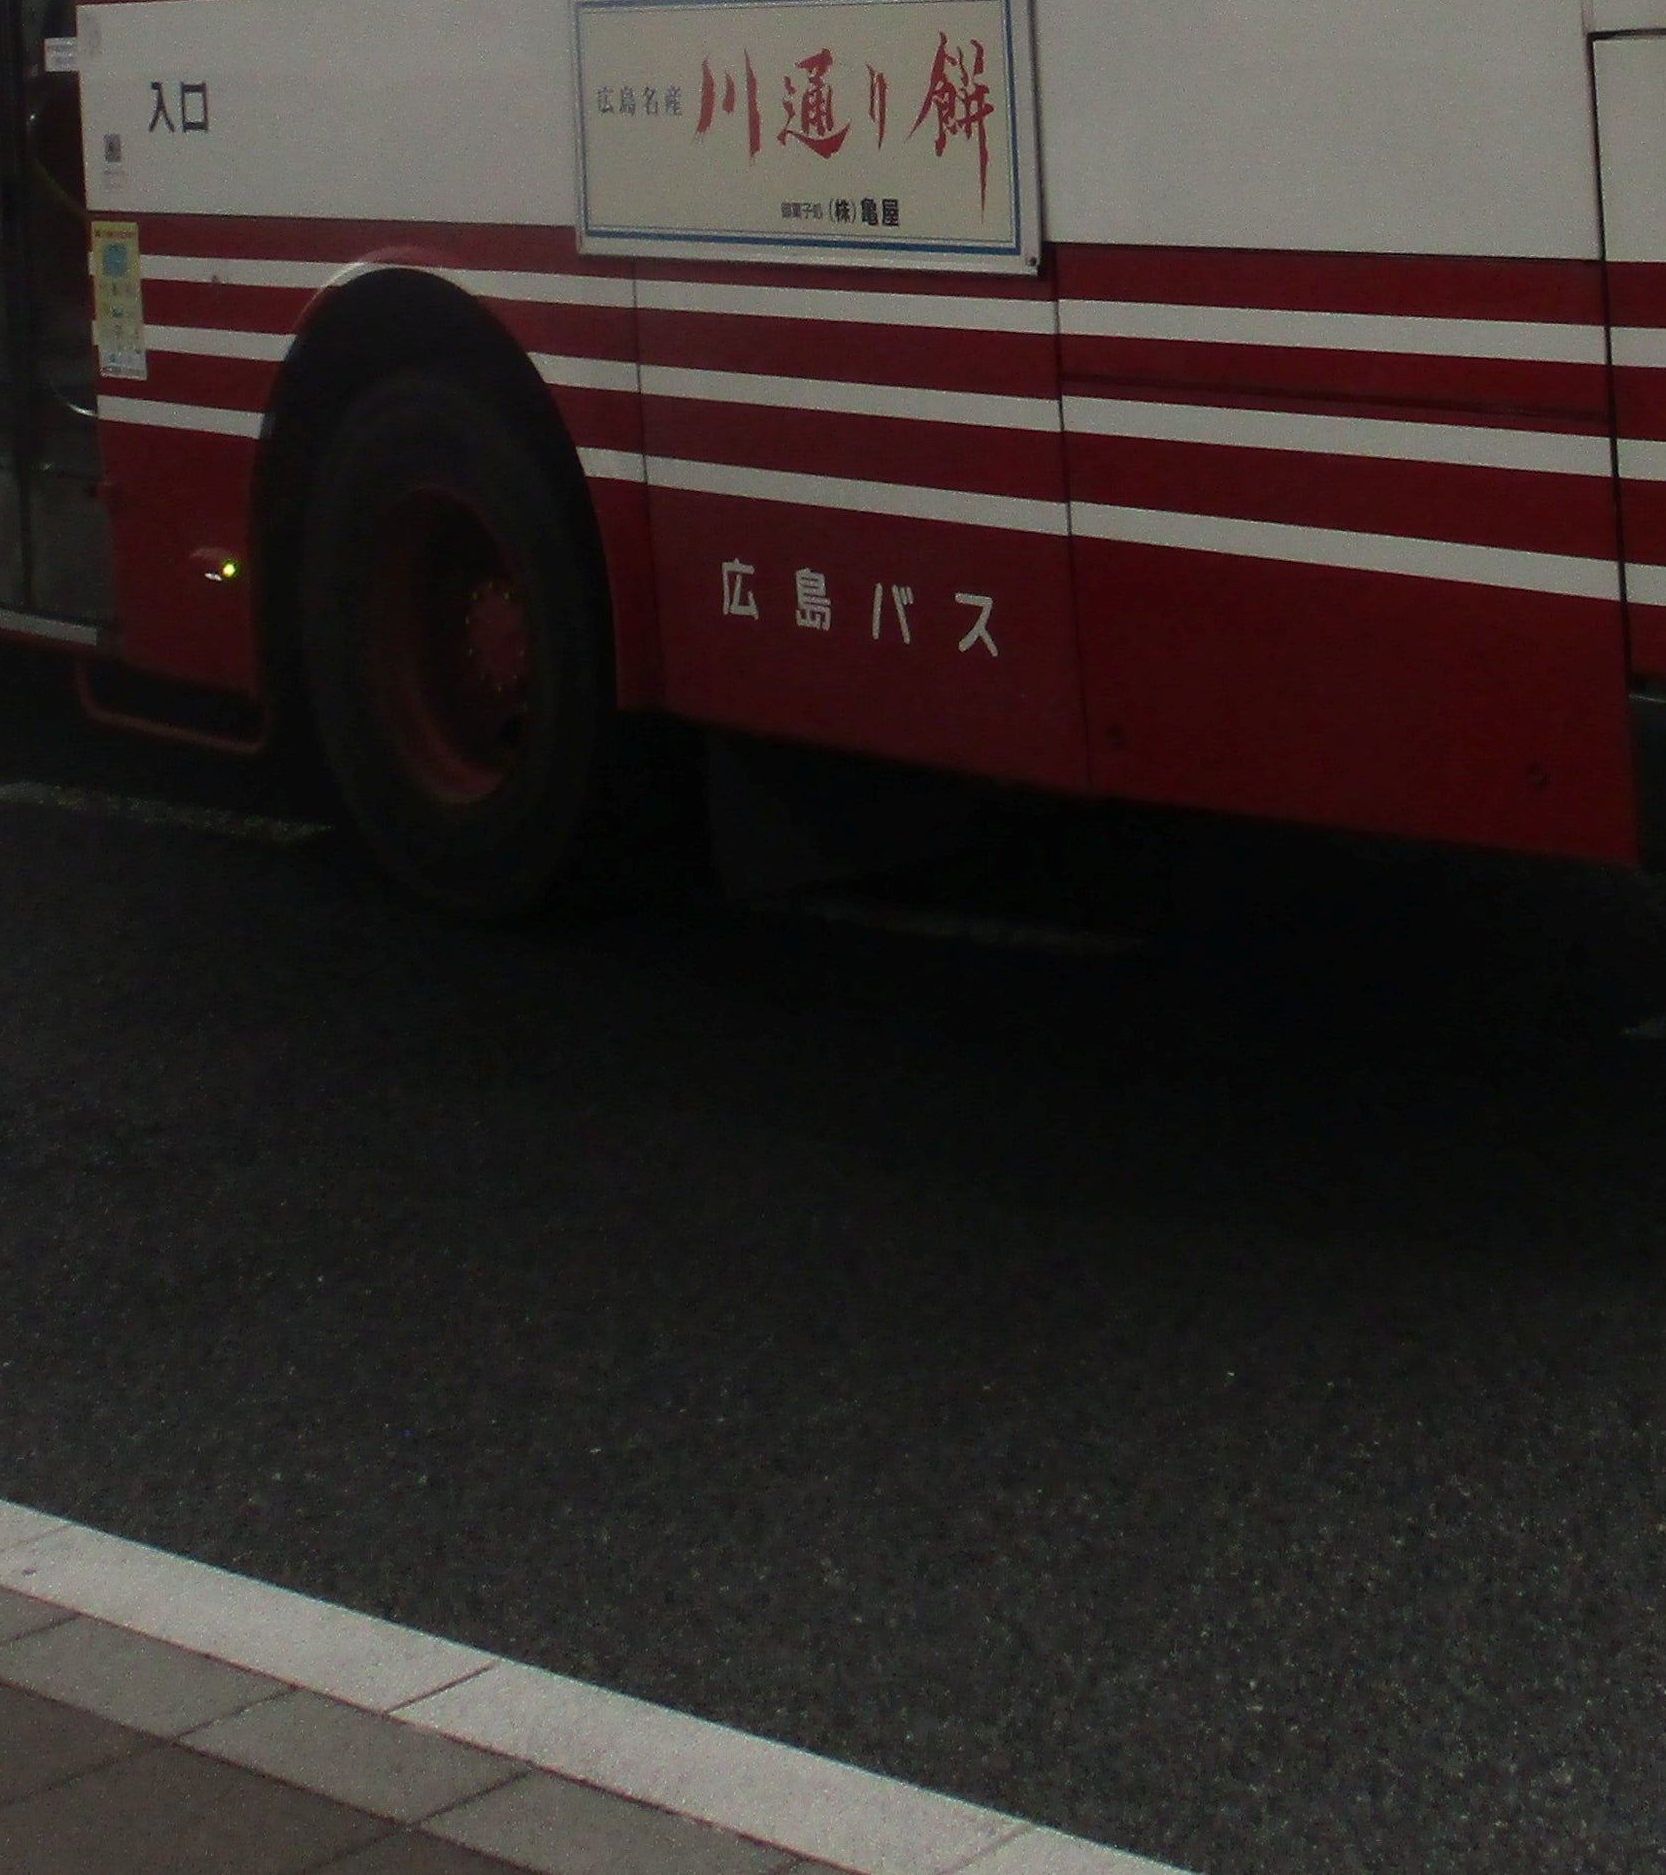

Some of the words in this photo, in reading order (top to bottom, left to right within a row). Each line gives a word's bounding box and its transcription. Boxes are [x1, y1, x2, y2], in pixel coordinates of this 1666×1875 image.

[149, 81, 209, 133] 入口
[596, 84, 683, 118] 広島名産
[693, 31, 995, 224] 川通り餅
[721, 557, 999, 657] 広島バス
